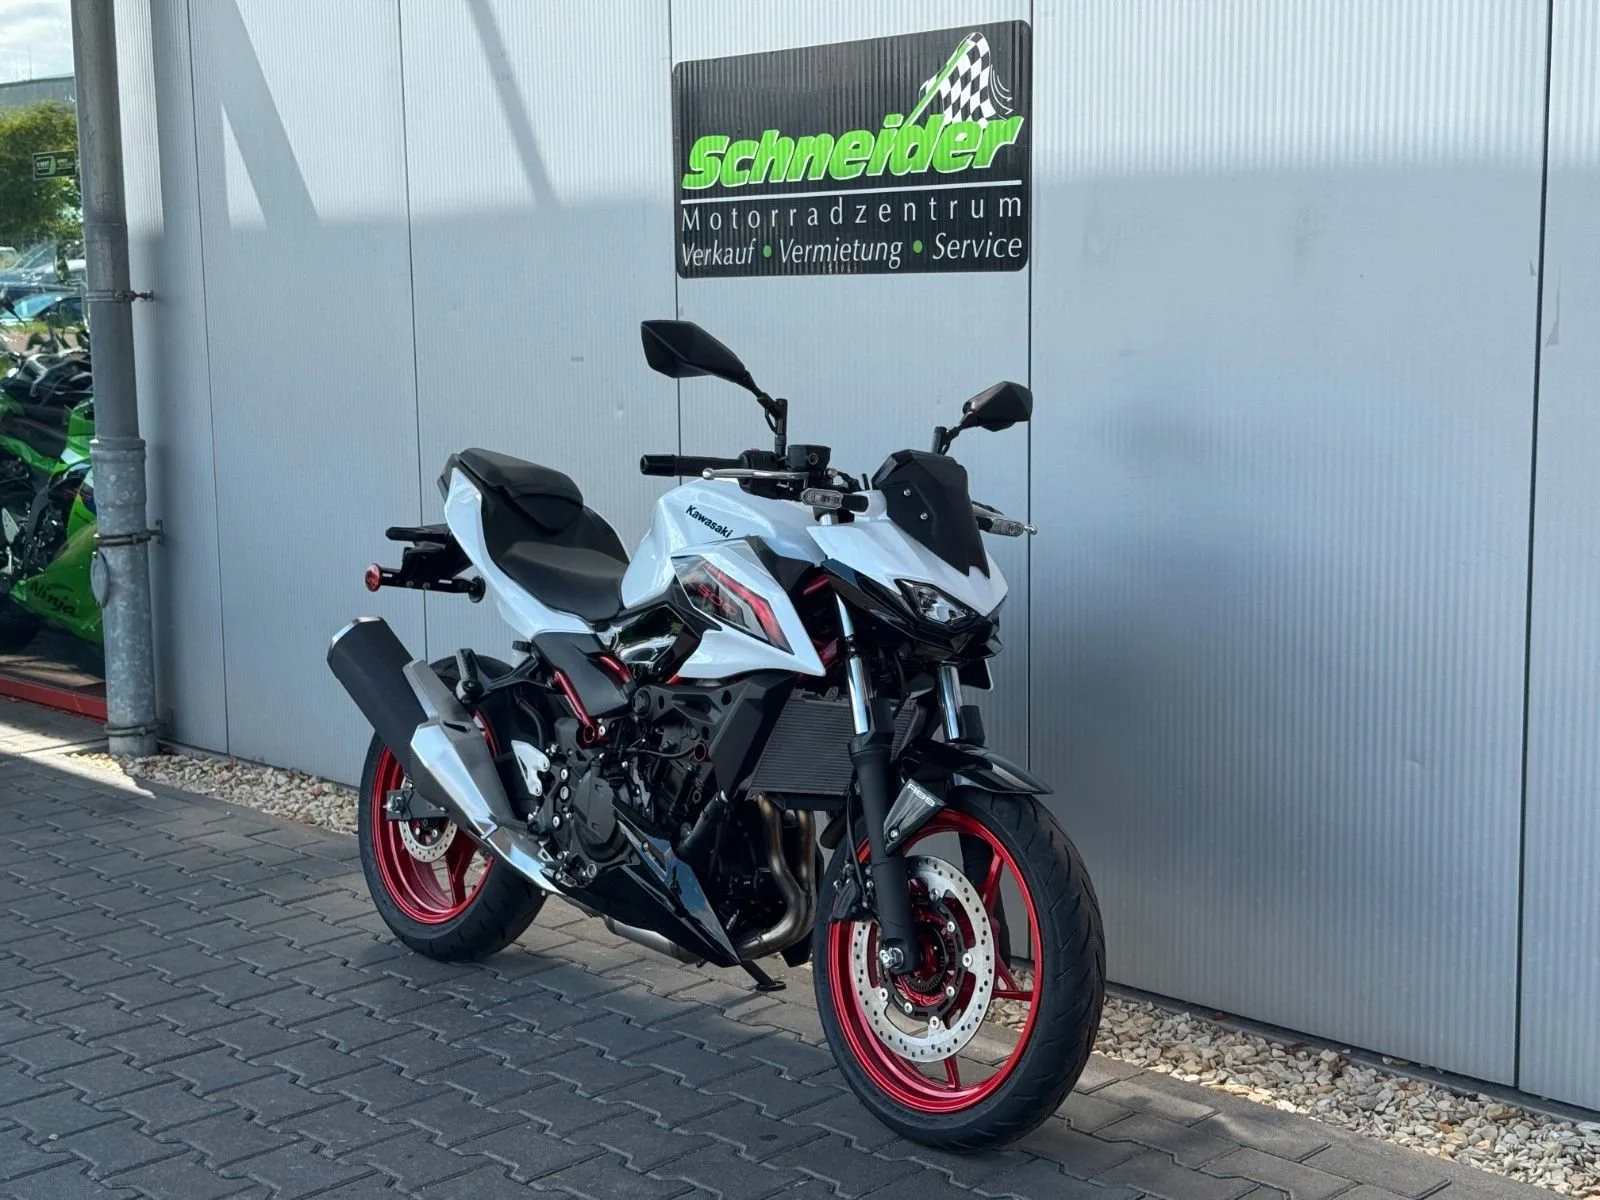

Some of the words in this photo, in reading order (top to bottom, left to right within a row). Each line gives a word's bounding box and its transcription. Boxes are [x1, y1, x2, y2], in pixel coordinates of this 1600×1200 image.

[682, 114, 1024, 190] Schneider
[682, 197, 1022, 231] Motorradzentrum
[682, 239, 755, 267] Verkauf
[780, 236, 903, 270] Vermietung
[932, 231, 1023, 260] Service
[686, 504, 733, 538] Kawasaki
[29, 580, 80, 618] Ninja
[907, 783, 936, 807] ABS
